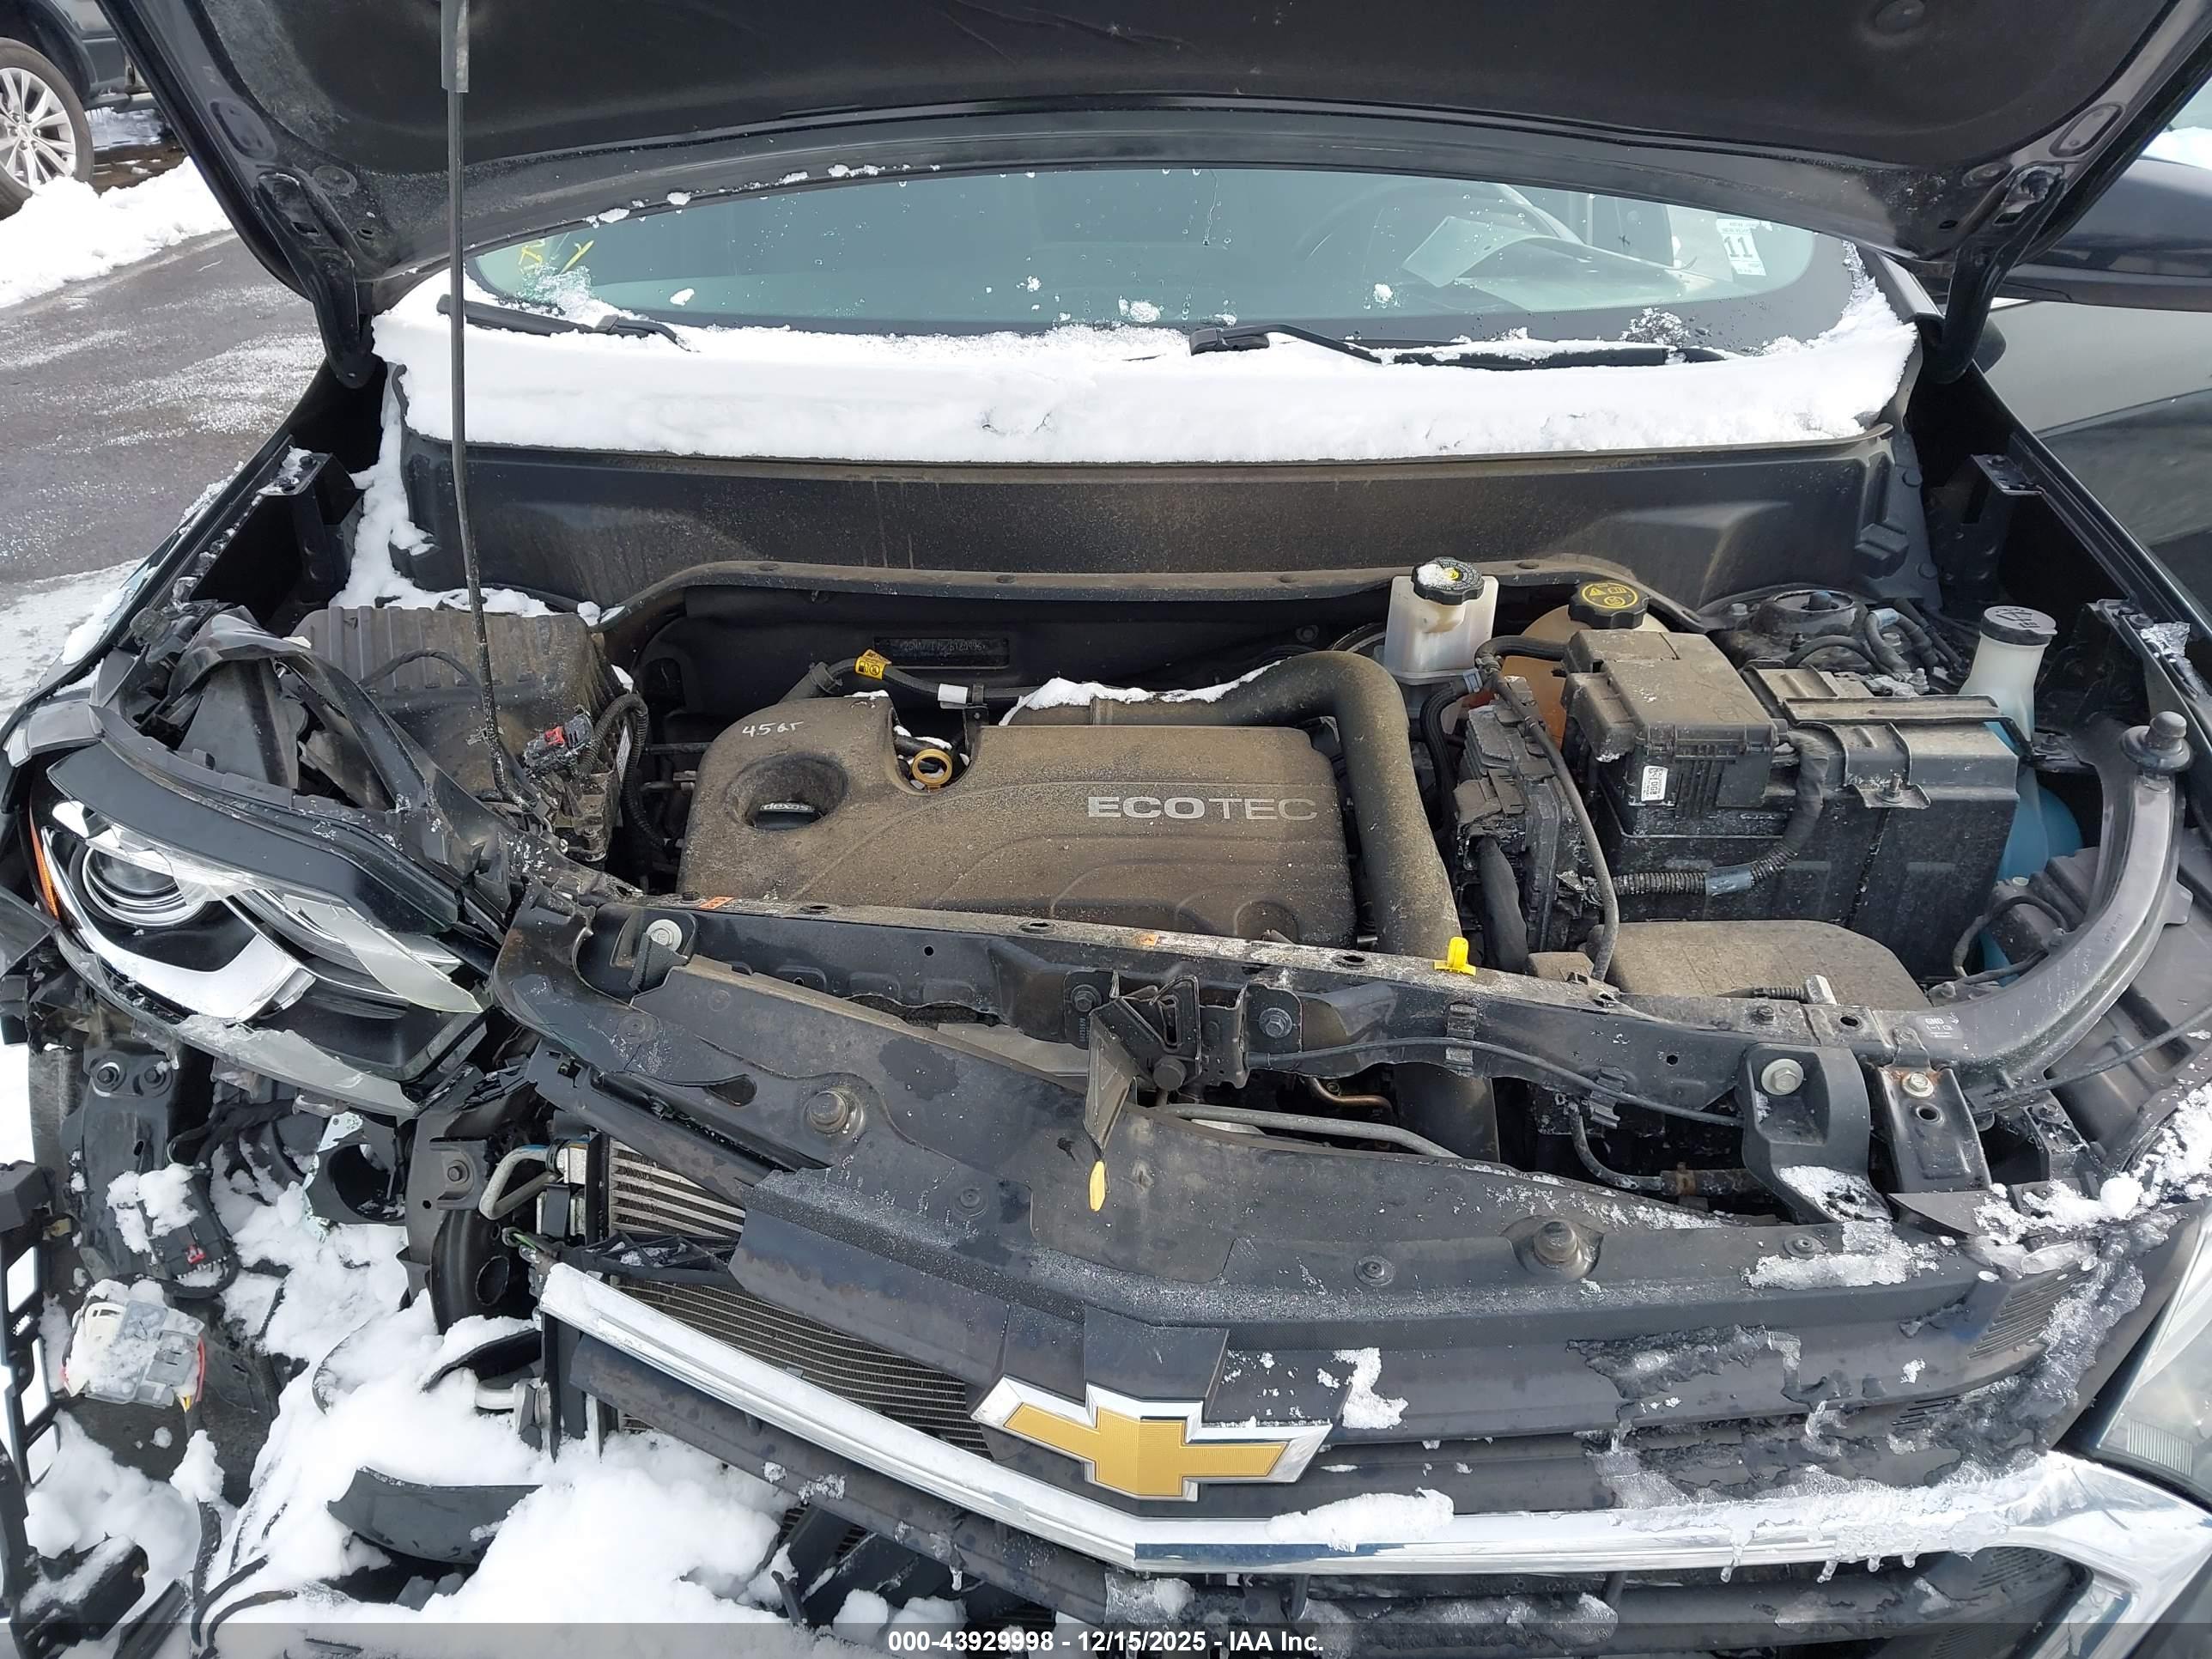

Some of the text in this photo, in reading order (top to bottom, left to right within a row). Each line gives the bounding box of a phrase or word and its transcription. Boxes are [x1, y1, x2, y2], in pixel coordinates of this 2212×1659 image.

[1724, 236, 1753, 258] 11
[763, 802, 810, 811] dexos
[1087, 796, 1319, 822] ECOTEC
